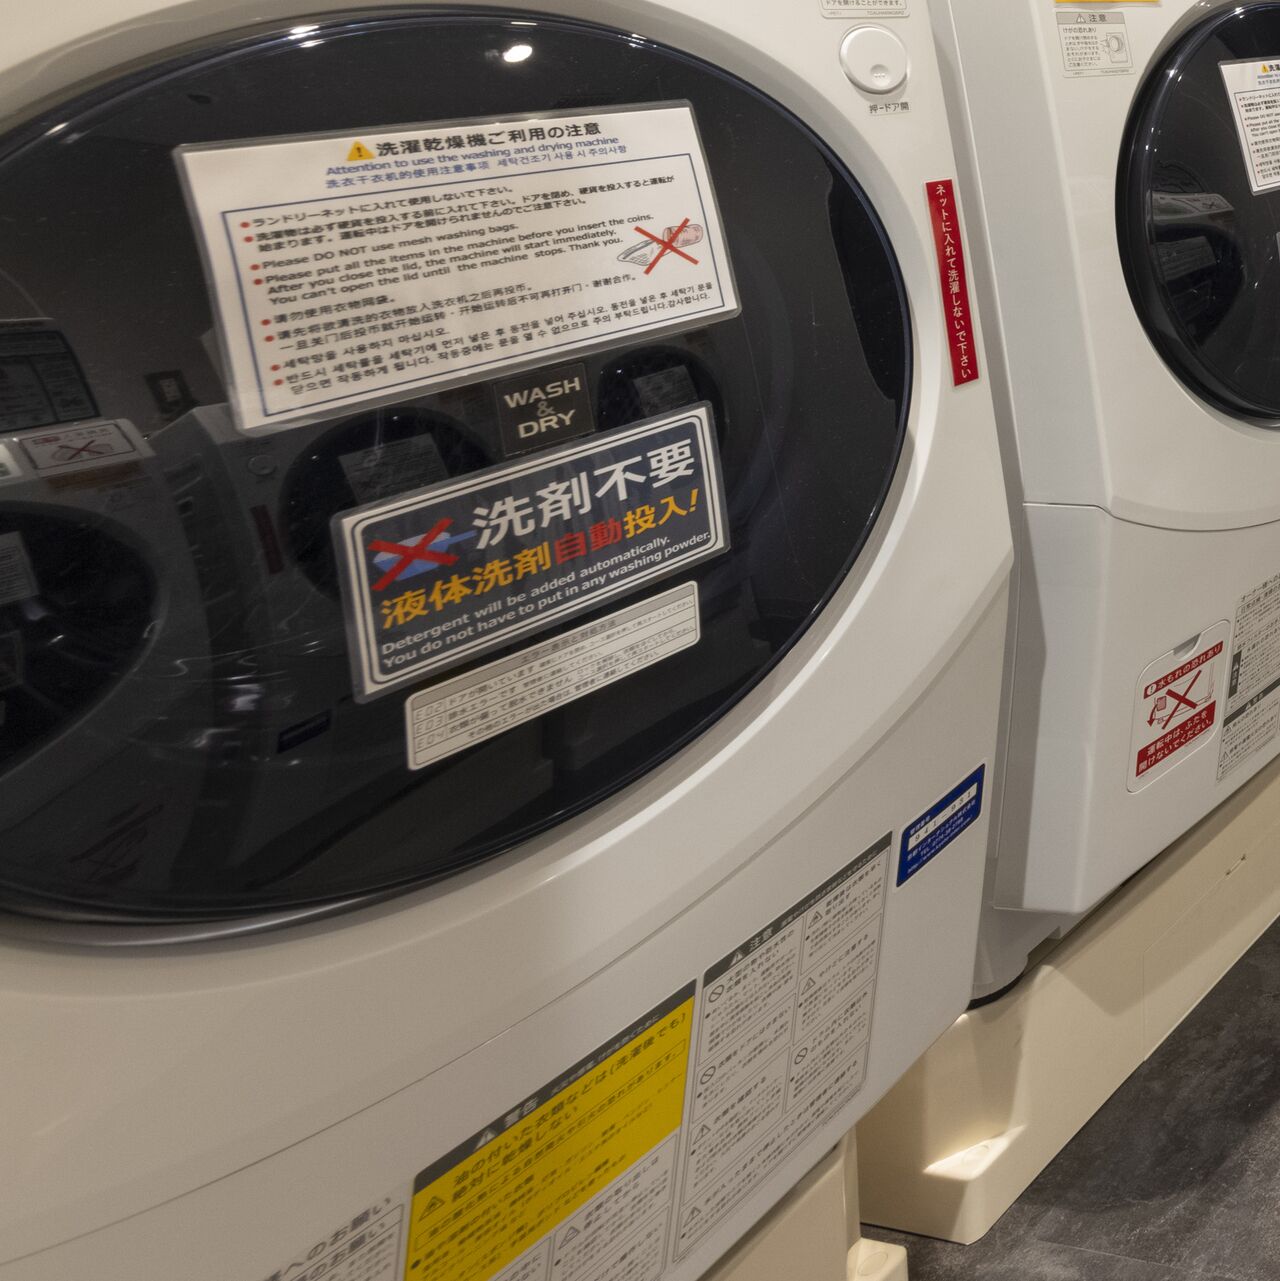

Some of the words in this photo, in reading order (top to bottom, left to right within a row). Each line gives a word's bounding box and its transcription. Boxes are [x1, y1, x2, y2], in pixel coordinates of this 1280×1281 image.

[325, 160, 391, 176] Attention
[393, 158, 408, 169] to
[411, 155, 435, 167] use
[437, 153, 459, 164] the
[461, 147, 511, 161] washing
[513, 145, 536, 156] and
[537, 141, 573, 153] drying
[574, 136, 619, 149] machine
[375, 121, 601, 157] 洗濯乾燥機ご利用の注意
[262, 254, 310, 270] Please
[313, 250, 335, 262] DO
[338, 245, 369, 258] NOT
[370, 241, 395, 253] use
[397, 235, 433, 249] mesh
[435, 227, 486, 243] washing
[488, 222, 519, 235] bags.
[265, 267, 313, 284] Please
[315, 263, 340, 276] put
[343, 259, 360, 271] all
[362, 255, 386, 268] the
[389, 249, 425, 264] items
[427, 246, 440, 257] in
[442, 243, 464, 255] the
[466, 234, 516, 251] machine
[517, 229, 553, 242] before
[555, 225, 575, 236] you
[577, 220, 606, 233] insert
[608, 217, 625, 227] the
[626, 212, 654, 224] coins.
[935, 185, 971, 378] ネットに入れて洗濯しないで下さい
[504, 377, 581, 409] WASH
[537, 402, 555, 416] &
[518, 409, 576, 439] DRY
[470, 437, 698, 552] 洗剤不要
[381, 611, 469, 657] Detergent
[474, 598, 502, 619] will
[505, 589, 526, 607] be
[529, 570, 575, 597] added
[578, 533, 671, 579] automatically.
[384, 645, 421, 669] You
[423, 636, 442, 654] do
[445, 624, 474, 645] not
[477, 607, 515, 632] have
[517, 600, 534, 616] to
[536, 589, 564, 610] put
[565, 581, 579, 597] in
[581, 572, 607, 592] any
[608, 548, 662, 580] washing
[663, 529, 711, 557] powder.
